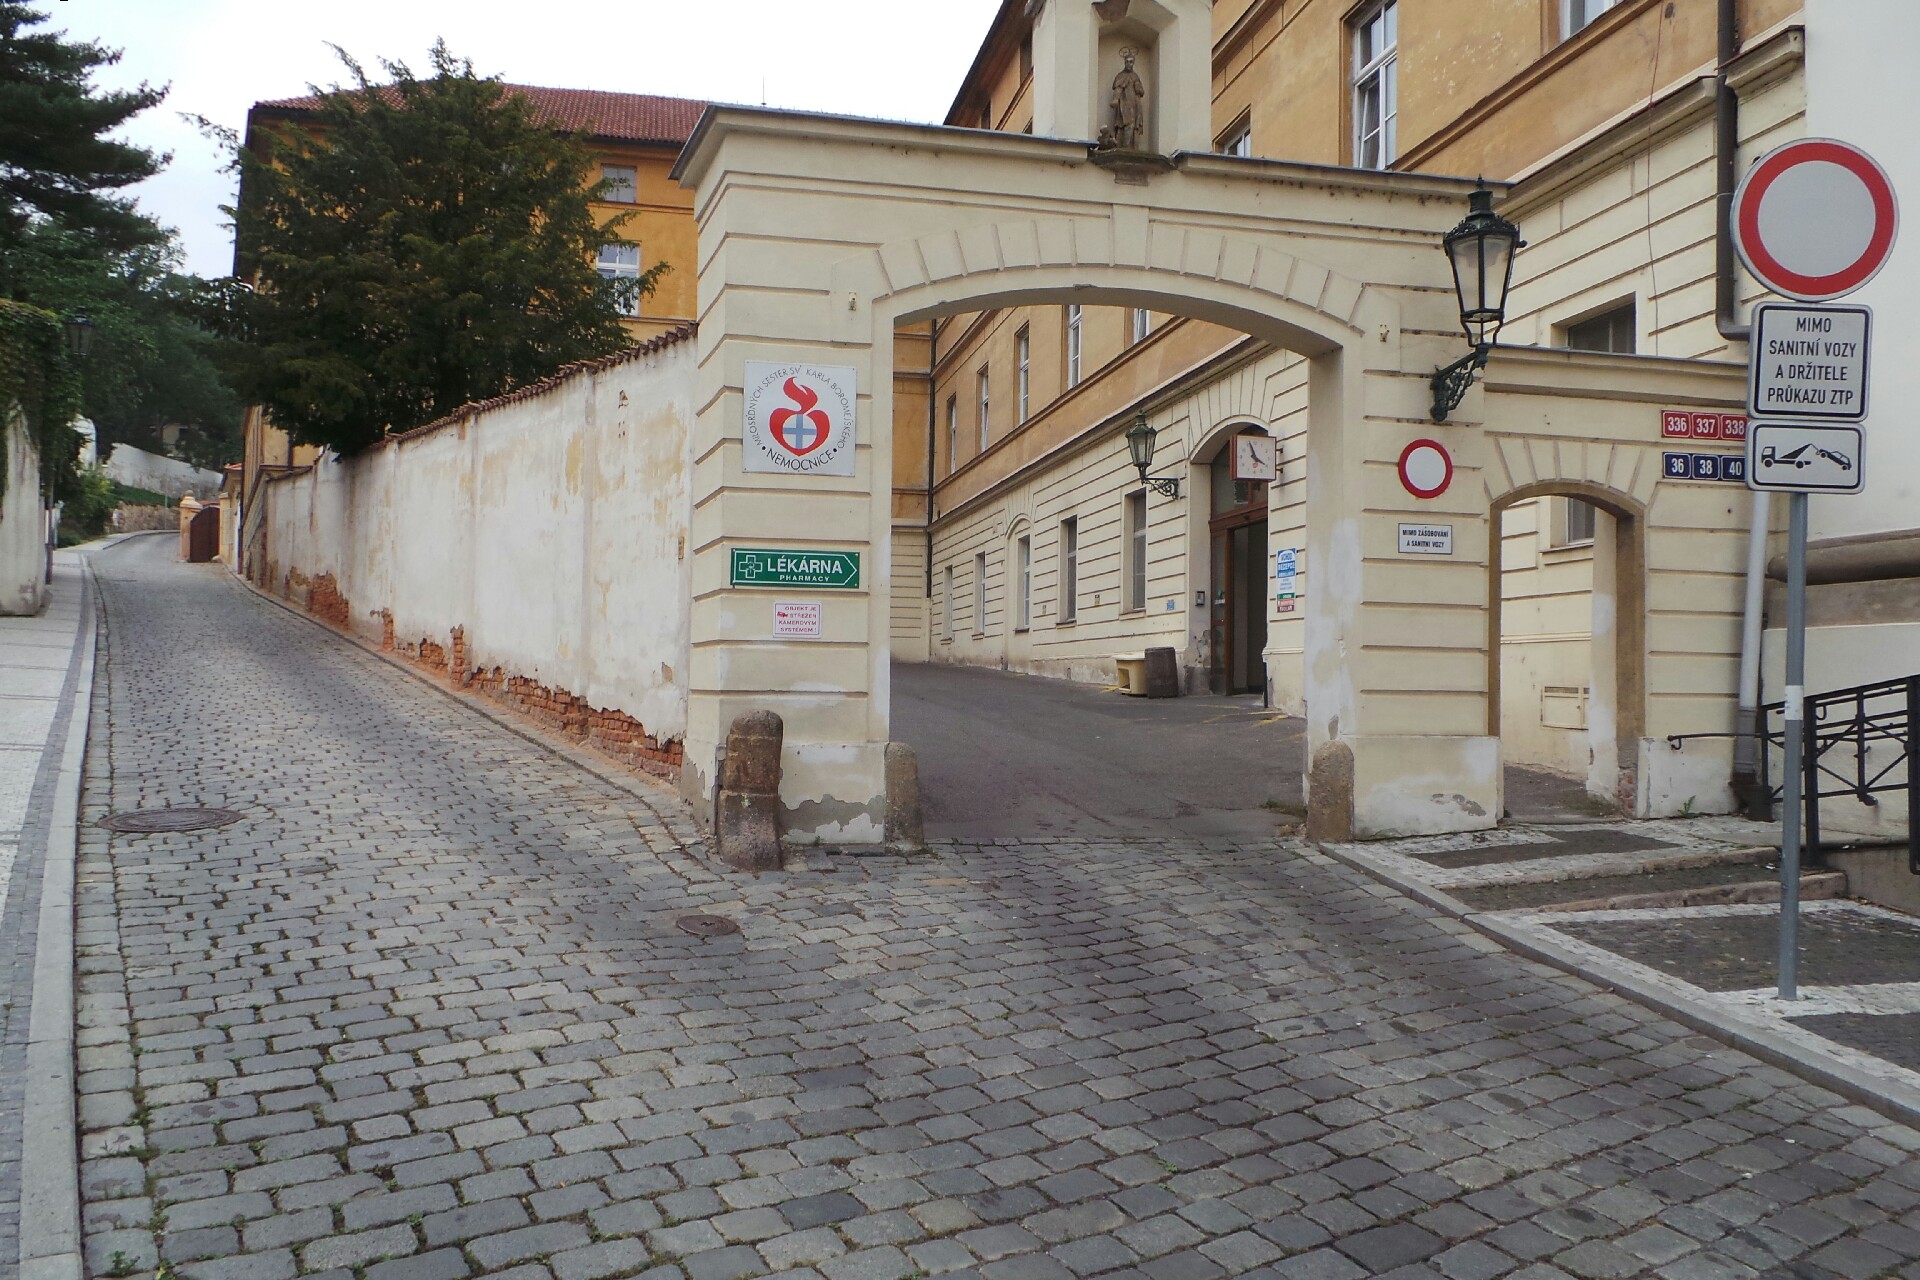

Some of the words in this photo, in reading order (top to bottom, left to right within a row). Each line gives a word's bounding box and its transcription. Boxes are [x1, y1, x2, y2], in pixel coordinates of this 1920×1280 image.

[1795, 317, 1832, 333] MIMO
[1769, 338, 1820, 356] SANITNÍ
[1824, 342, 1857, 357] VOZY
[762, 368, 787, 388] SESTER
[805, 368, 831, 385] KARLA
[1775, 364, 1784, 379] A
[1788, 361, 1848, 380] DRŽITELE
[1767, 384, 1827, 404] PRŮKAZU
[1830, 389, 1854, 405] ZTP
[1668, 417, 1687, 432] 336
[1696, 418, 1716, 434] 337
[1725, 419, 1745, 435] 338
[766, 448, 835, 471] NEMOCNICE
[1671, 458, 1685, 473] 36
[1699, 459, 1713, 475] 38
[1729, 461, 1742, 476] 40
[767, 555, 843, 574] LÉKÁRNA
[780, 575, 830, 583] PHARMACY
